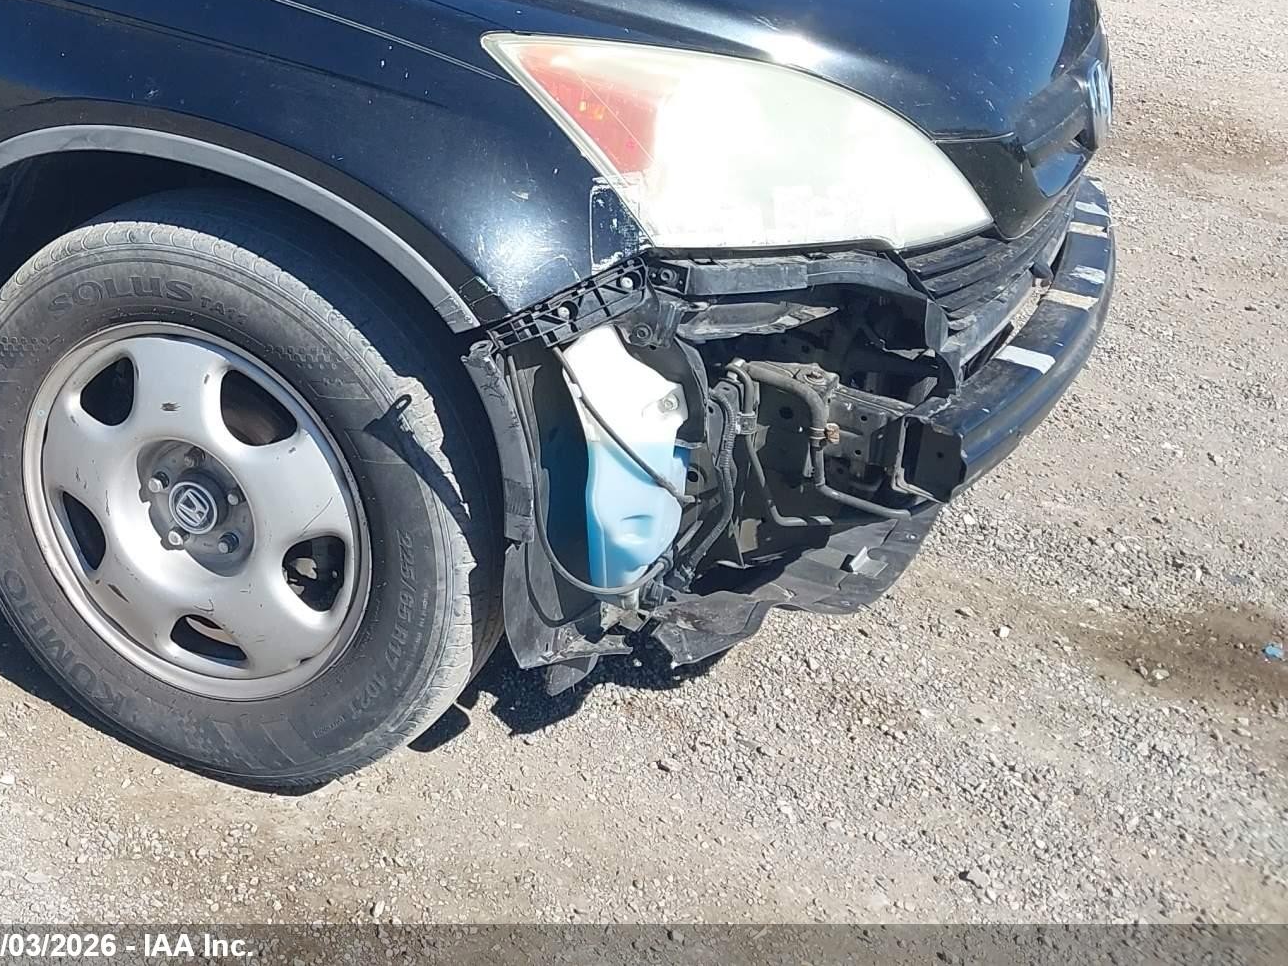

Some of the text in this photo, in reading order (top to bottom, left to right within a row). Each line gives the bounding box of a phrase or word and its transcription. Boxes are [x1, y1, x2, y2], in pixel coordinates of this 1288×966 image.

[47, 276, 194, 314] SOLUS
[395, 529, 417, 623] 225/65
[4, 569, 128, 718] KUMHO
